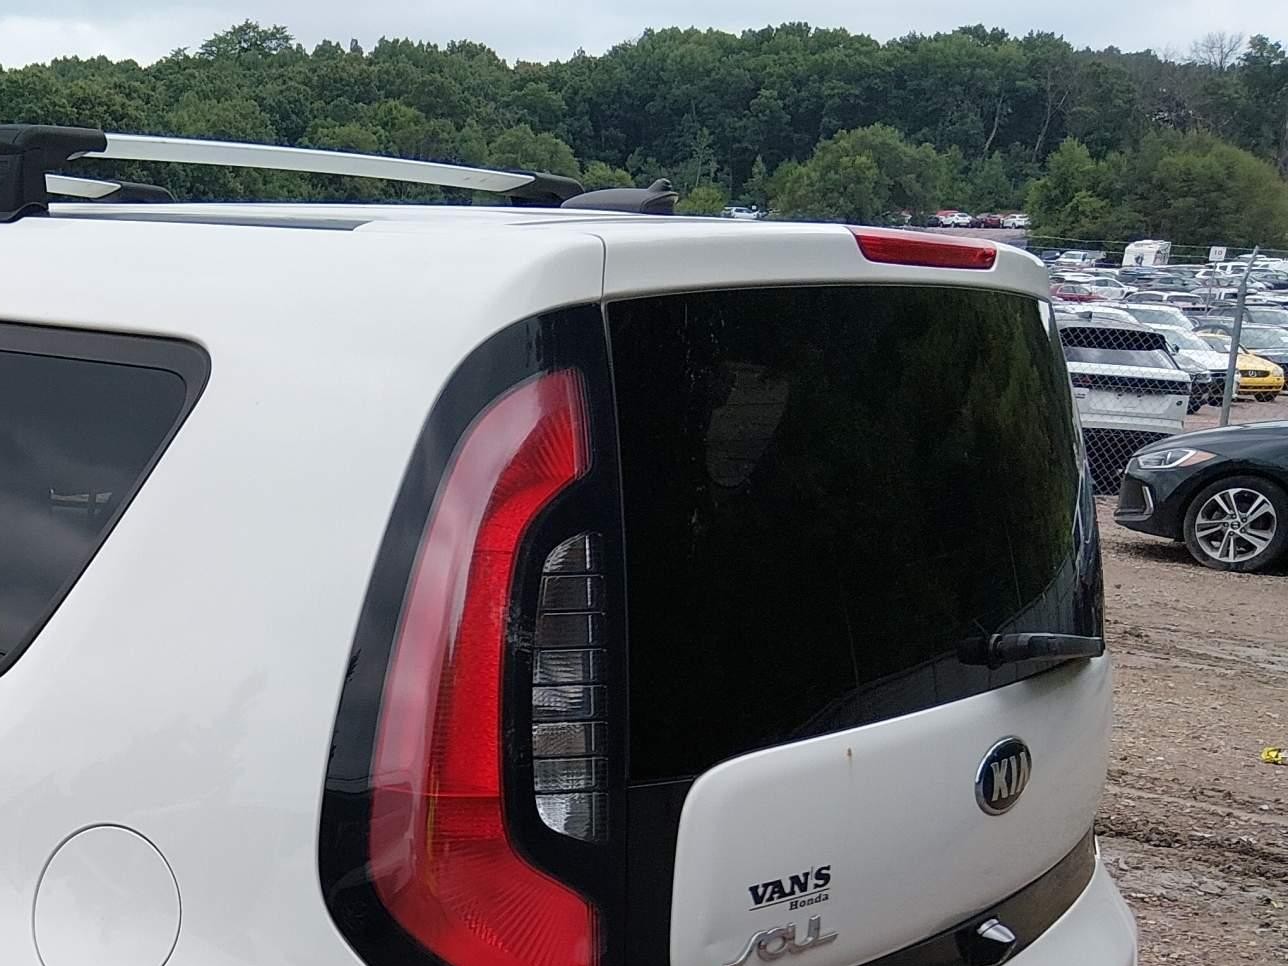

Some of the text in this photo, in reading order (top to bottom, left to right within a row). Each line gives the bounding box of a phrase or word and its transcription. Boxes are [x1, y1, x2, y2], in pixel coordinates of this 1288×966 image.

[990, 751, 1031, 802] KIA
[748, 864, 831, 906] VAN'S
[789, 892, 830, 911] Honda
